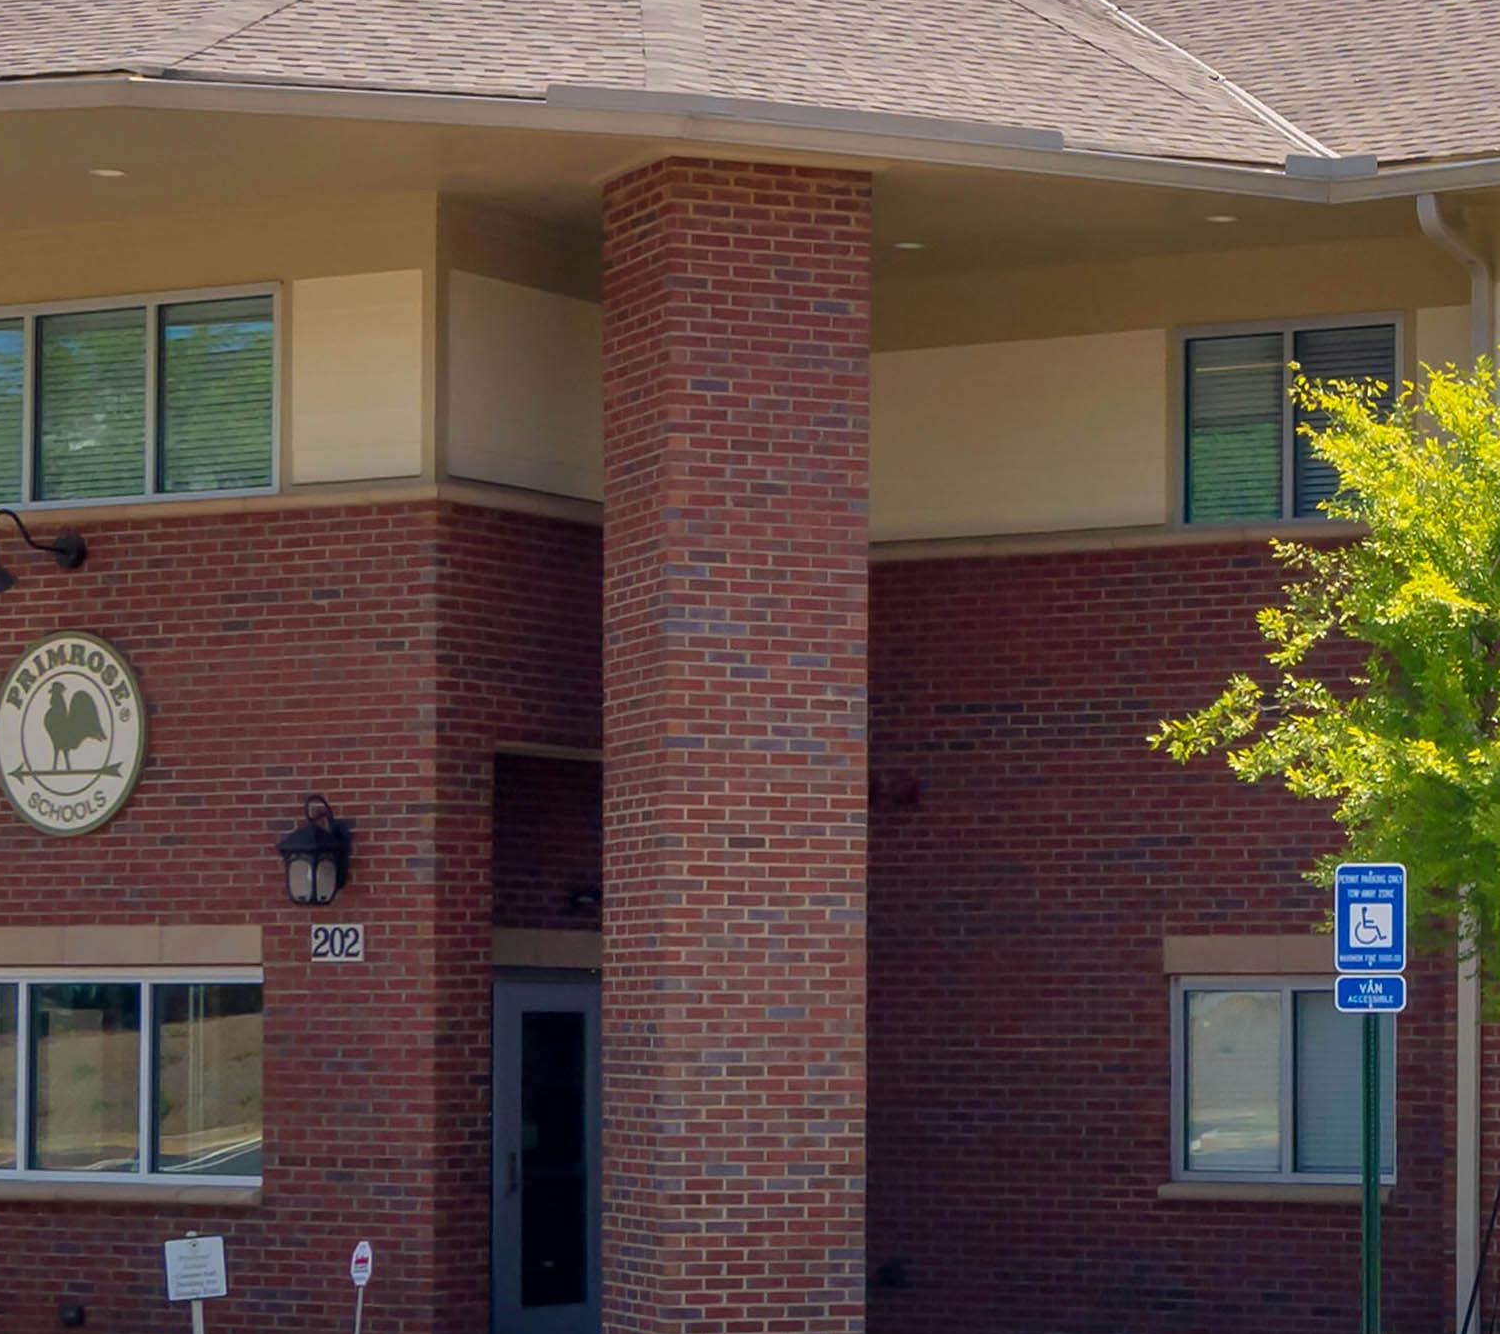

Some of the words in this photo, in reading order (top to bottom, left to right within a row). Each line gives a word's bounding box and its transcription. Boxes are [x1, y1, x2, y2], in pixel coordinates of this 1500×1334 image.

[27, 790, 107, 823] SCHOOLS
[1338, 874, 1359, 884] PERMIT
[1361, 874, 1386, 884] PARKING
[1388, 874, 1403, 884] ONLY
[1378, 889, 1395, 899] ZONE
[312, 927, 360, 957] 202
[1359, 982, 1383, 994] VAN
[1347, 995, 1394, 1004] ACCESSIBLE
